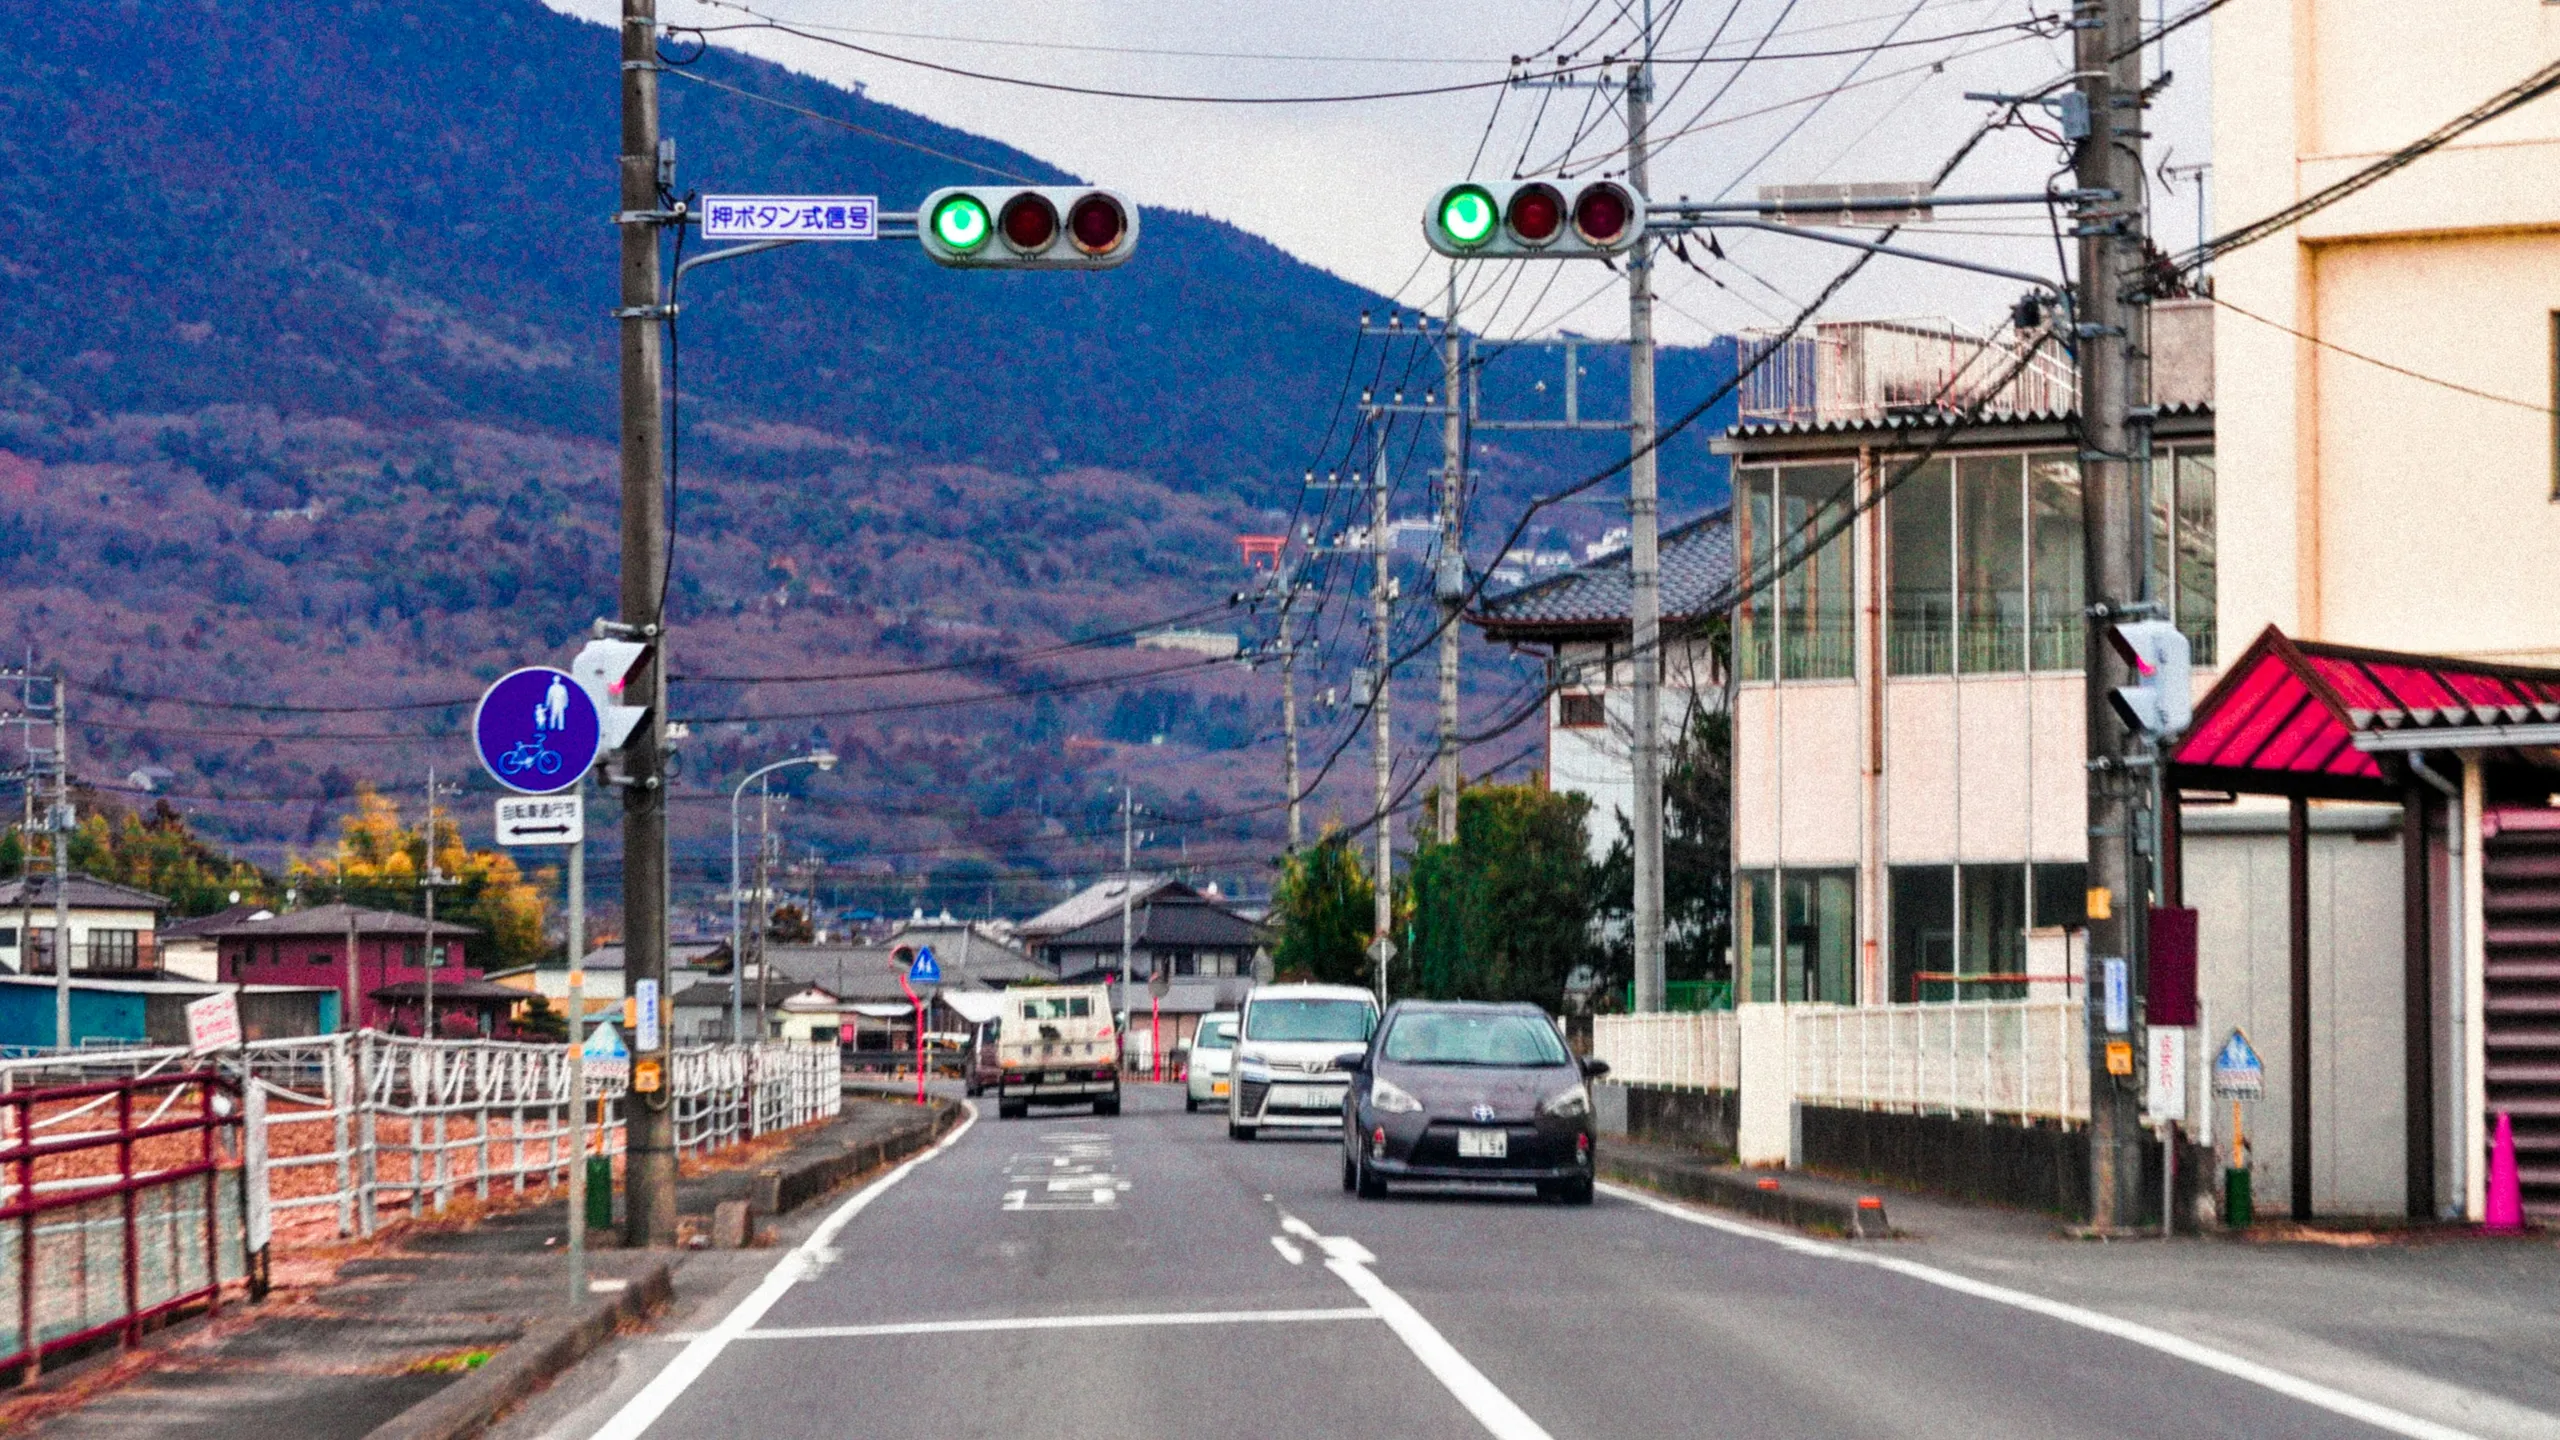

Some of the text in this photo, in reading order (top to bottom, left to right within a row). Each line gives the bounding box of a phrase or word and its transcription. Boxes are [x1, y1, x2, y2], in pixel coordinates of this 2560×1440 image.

[711, 205, 870, 230] 押ボタン式信号
[502, 802, 577, 821] 自転車通行可
